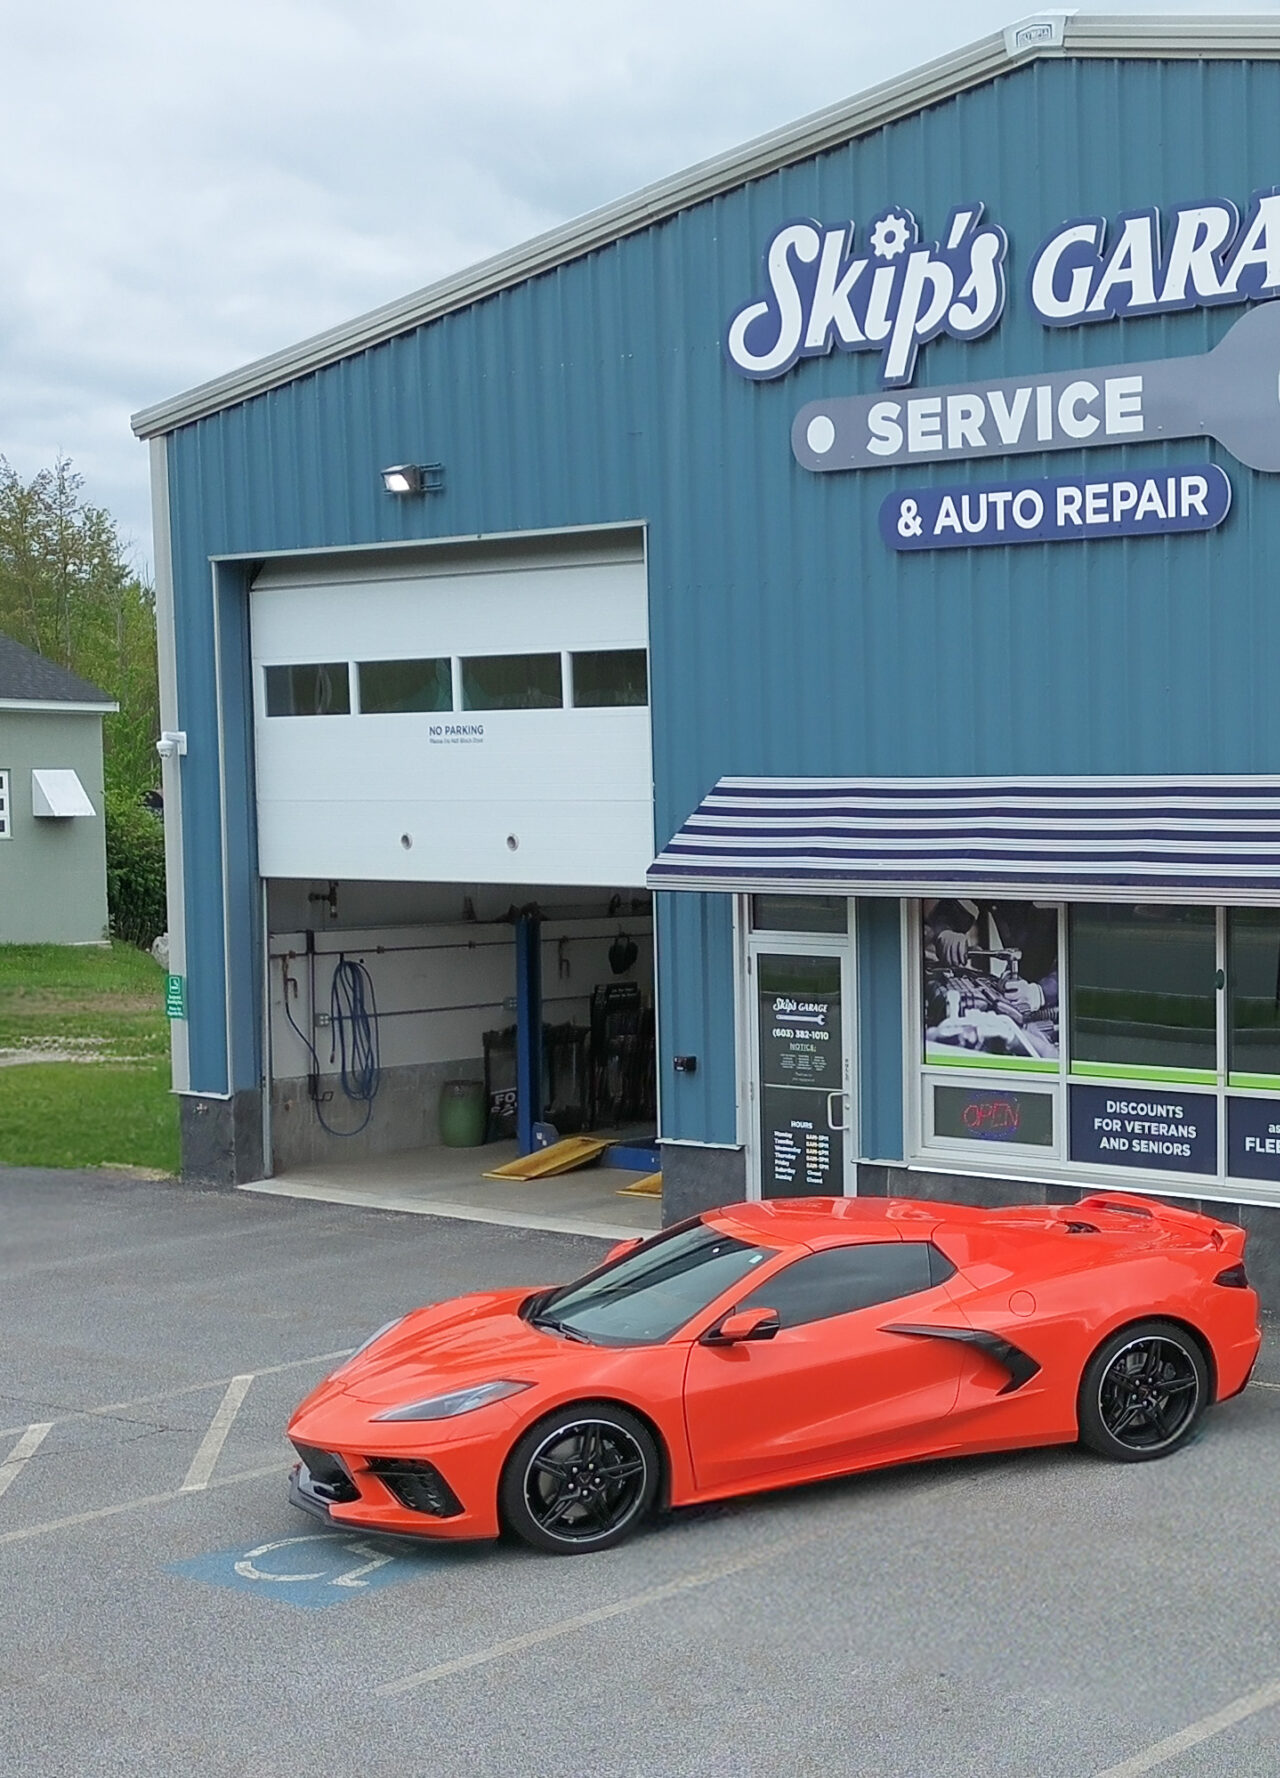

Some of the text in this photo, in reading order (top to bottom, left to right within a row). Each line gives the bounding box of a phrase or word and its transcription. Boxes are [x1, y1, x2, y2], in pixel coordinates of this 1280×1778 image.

[728, 212, 1000, 378] Skip's
[866, 375, 1144, 456] SERVICE
[897, 475, 1208, 537] & AUTO REPAIR
[429, 725, 484, 736] NO PARKING
[798, 1002, 828, 1013] GARAGE
[1106, 1100, 1184, 1119] DISCOUNTS
[1094, 1118, 1197, 1139] FOR VETERANS
[1099, 1136, 1192, 1157] AND SENIORS
